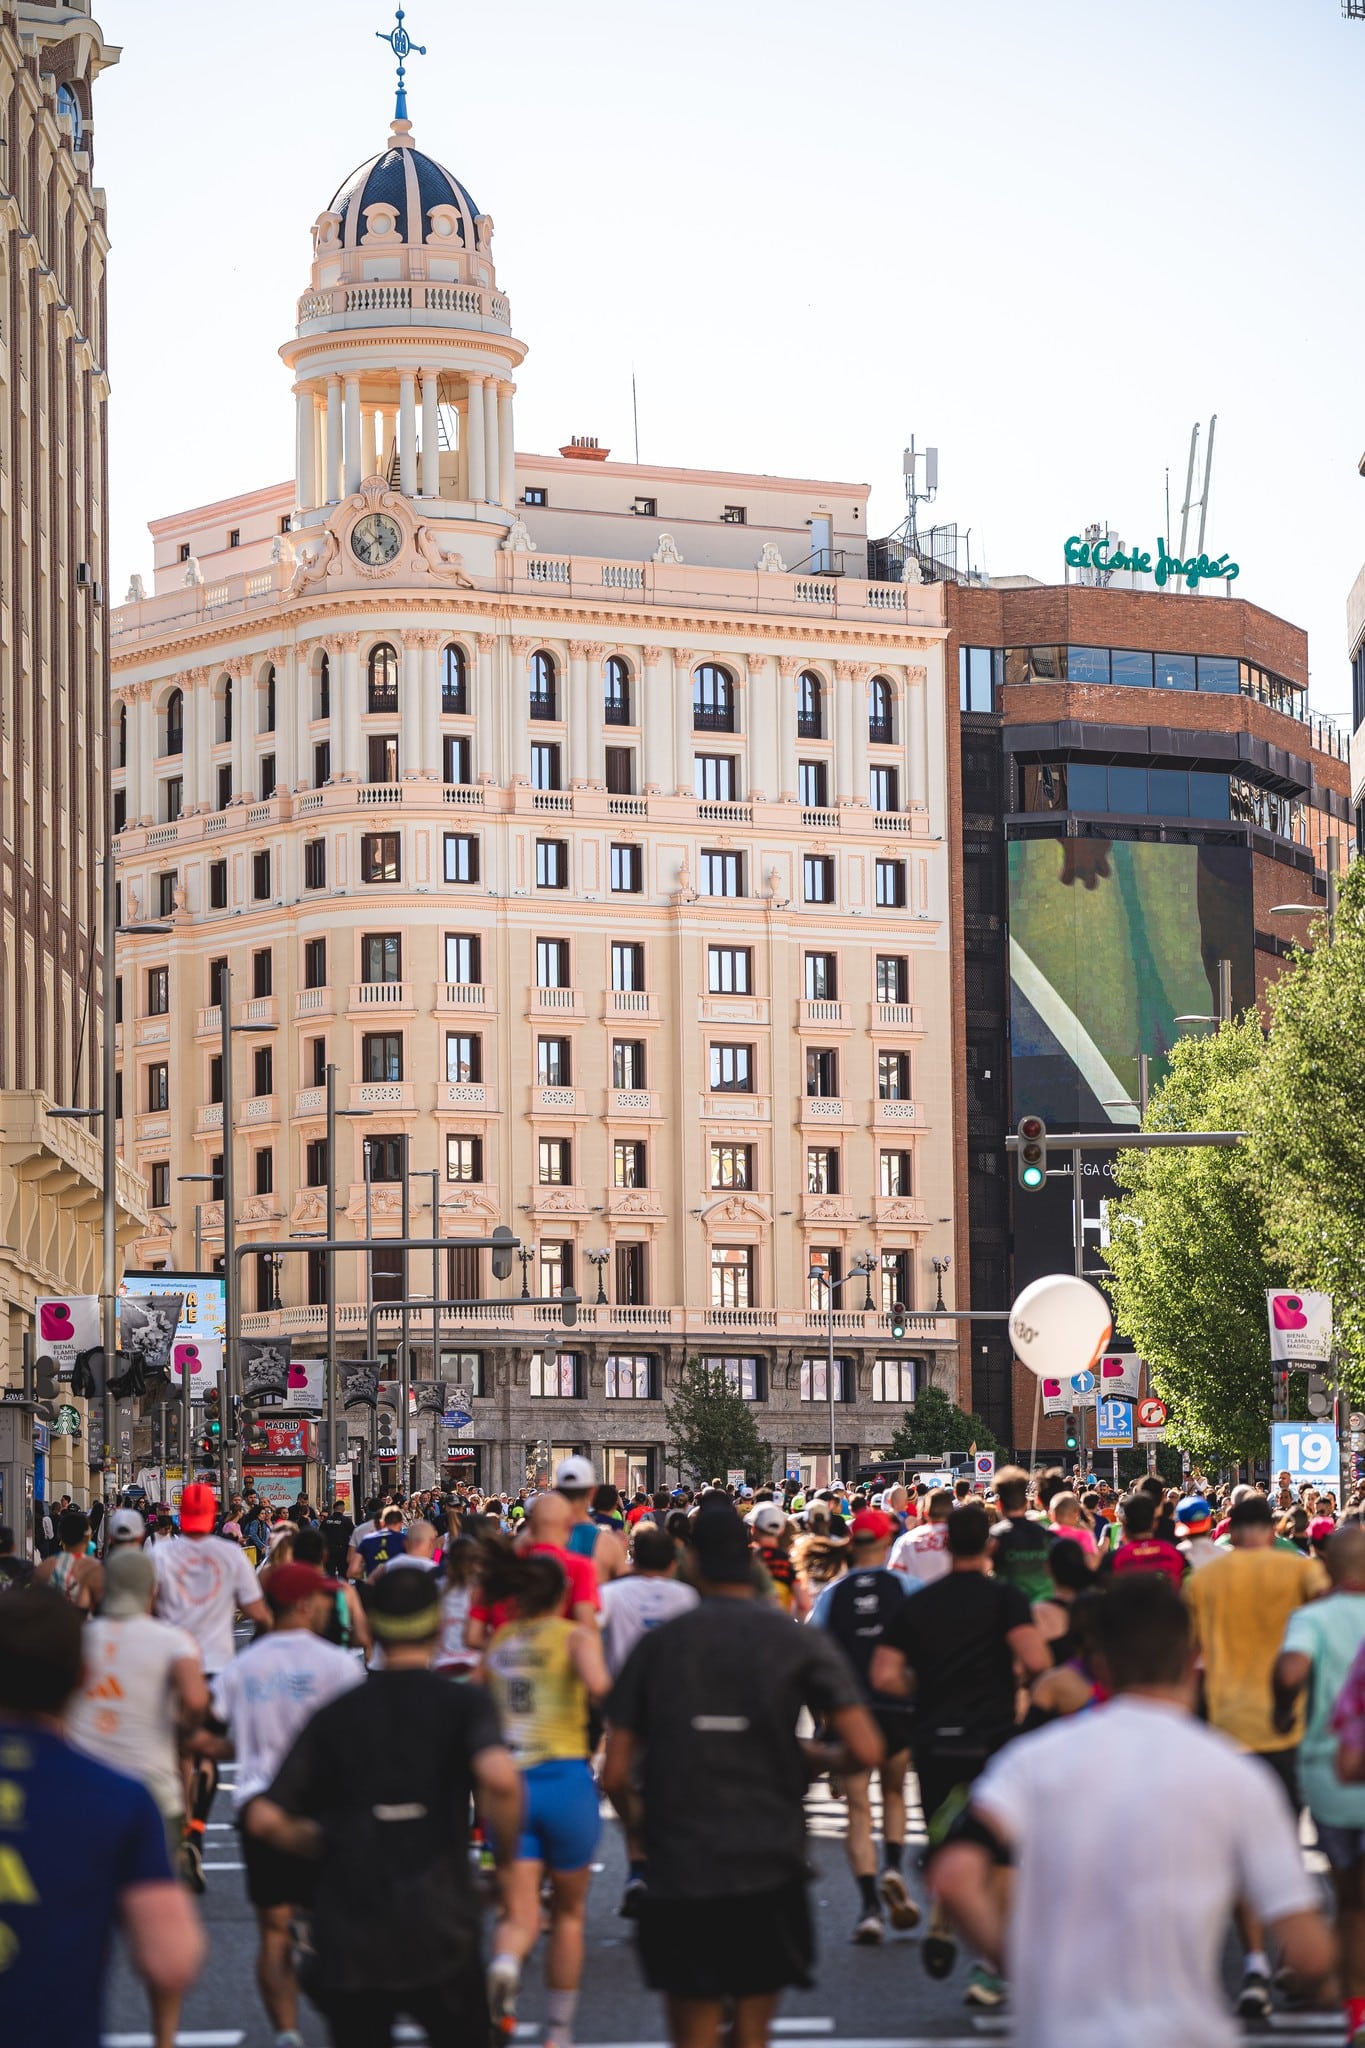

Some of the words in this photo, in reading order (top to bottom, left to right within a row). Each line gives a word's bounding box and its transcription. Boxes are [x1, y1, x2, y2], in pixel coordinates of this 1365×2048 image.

[1064, 535, 1091, 568] El
[1092, 540, 1153, 573] Corte
[1154, 537, 1240, 588] Inglés
[1294, 1362, 1317, 1370] MADRID
[1105, 1401, 1126, 1430] P
[264, 1420, 299, 1430] MADRID
[378, 1447, 398, 1457] RIM
[447, 1447, 475, 1456] RIMOR
[1281, 1433, 1332, 1472] 19
